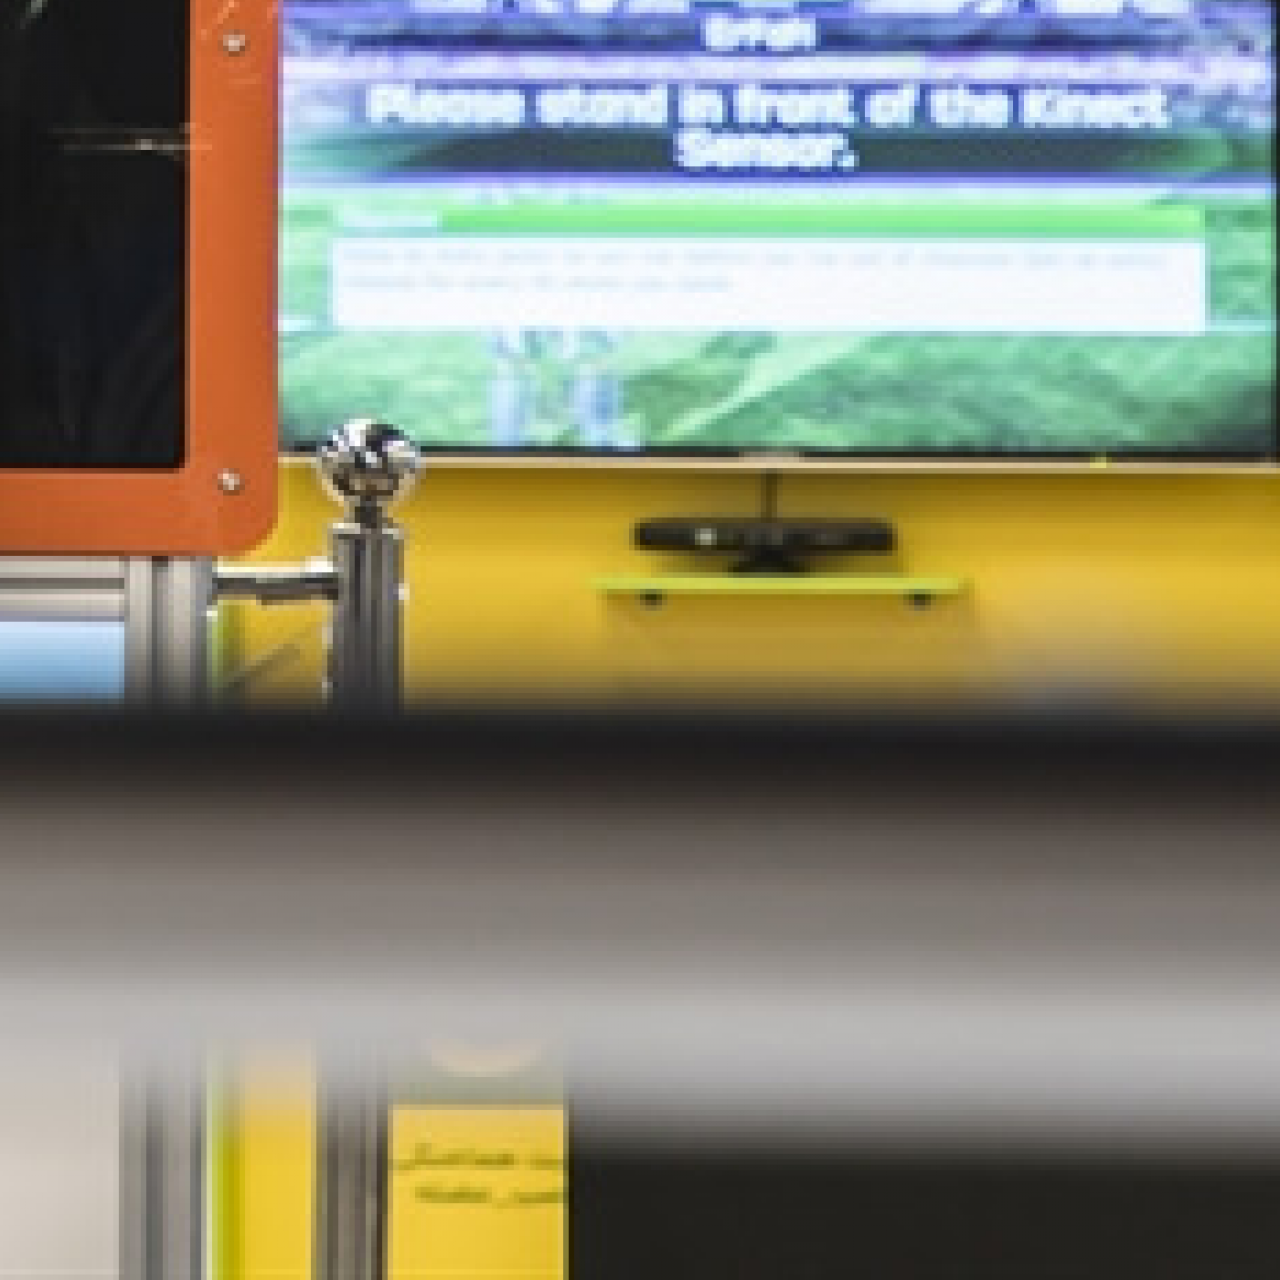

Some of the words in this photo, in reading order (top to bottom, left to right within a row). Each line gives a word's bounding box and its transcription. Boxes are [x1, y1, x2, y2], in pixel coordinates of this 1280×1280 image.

[367, 81, 526, 126] Please
[536, 82, 669, 126] stand
[677, 83, 723, 127] in
[734, 82, 856, 128] front
[863, 83, 918, 128] of
[928, 84, 1013, 129] the
[1022, 85, 1170, 130] Kinect
[676, 126, 860, 172] Sensor.
